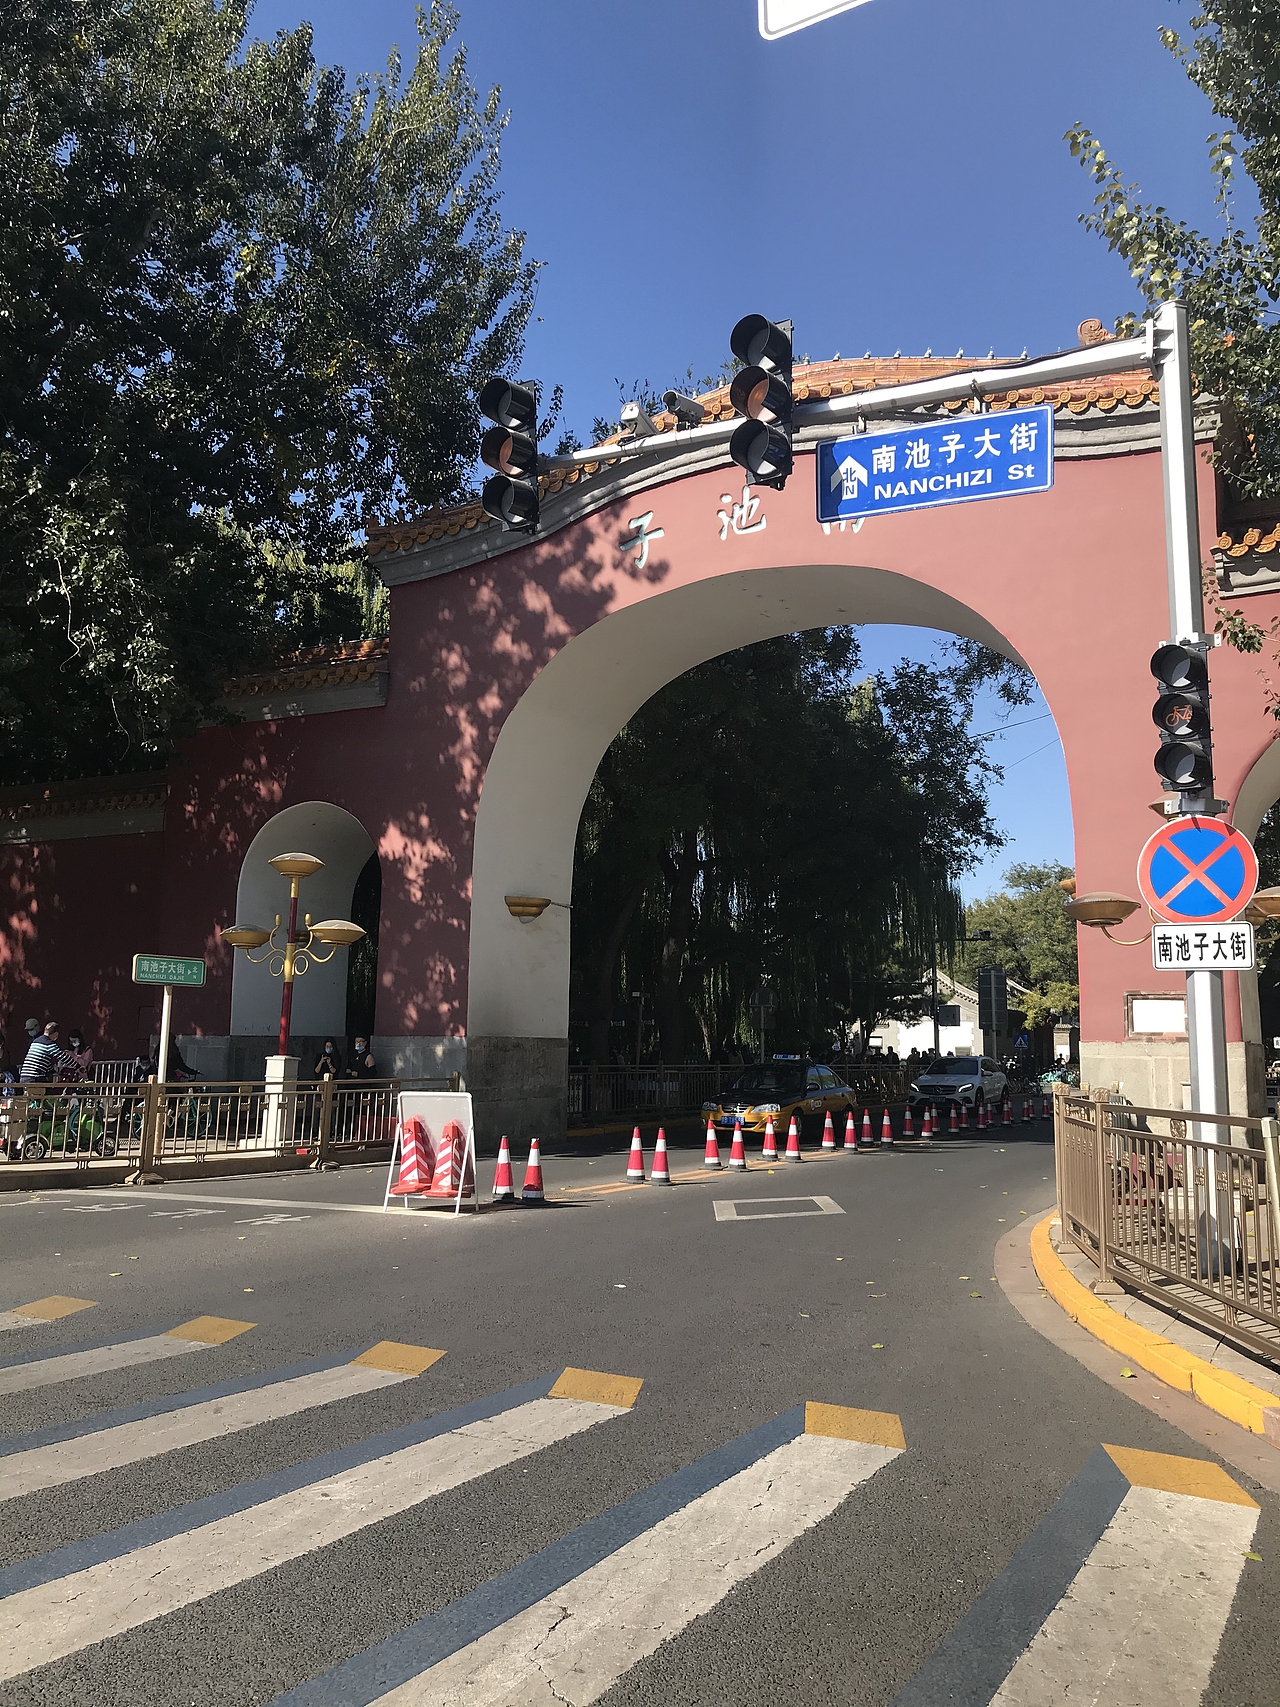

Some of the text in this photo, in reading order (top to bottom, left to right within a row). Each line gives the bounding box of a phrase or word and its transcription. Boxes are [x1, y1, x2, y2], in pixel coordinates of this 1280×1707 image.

[871, 422, 1038, 475] 南池子大街
[842, 467, 857, 483] 北
[874, 463, 1035, 500] NANCHIZI St
[845, 485, 855, 496] N
[1157, 931, 1246, 962] 南池子大街
[141, 960, 185, 974] 南池子大街
